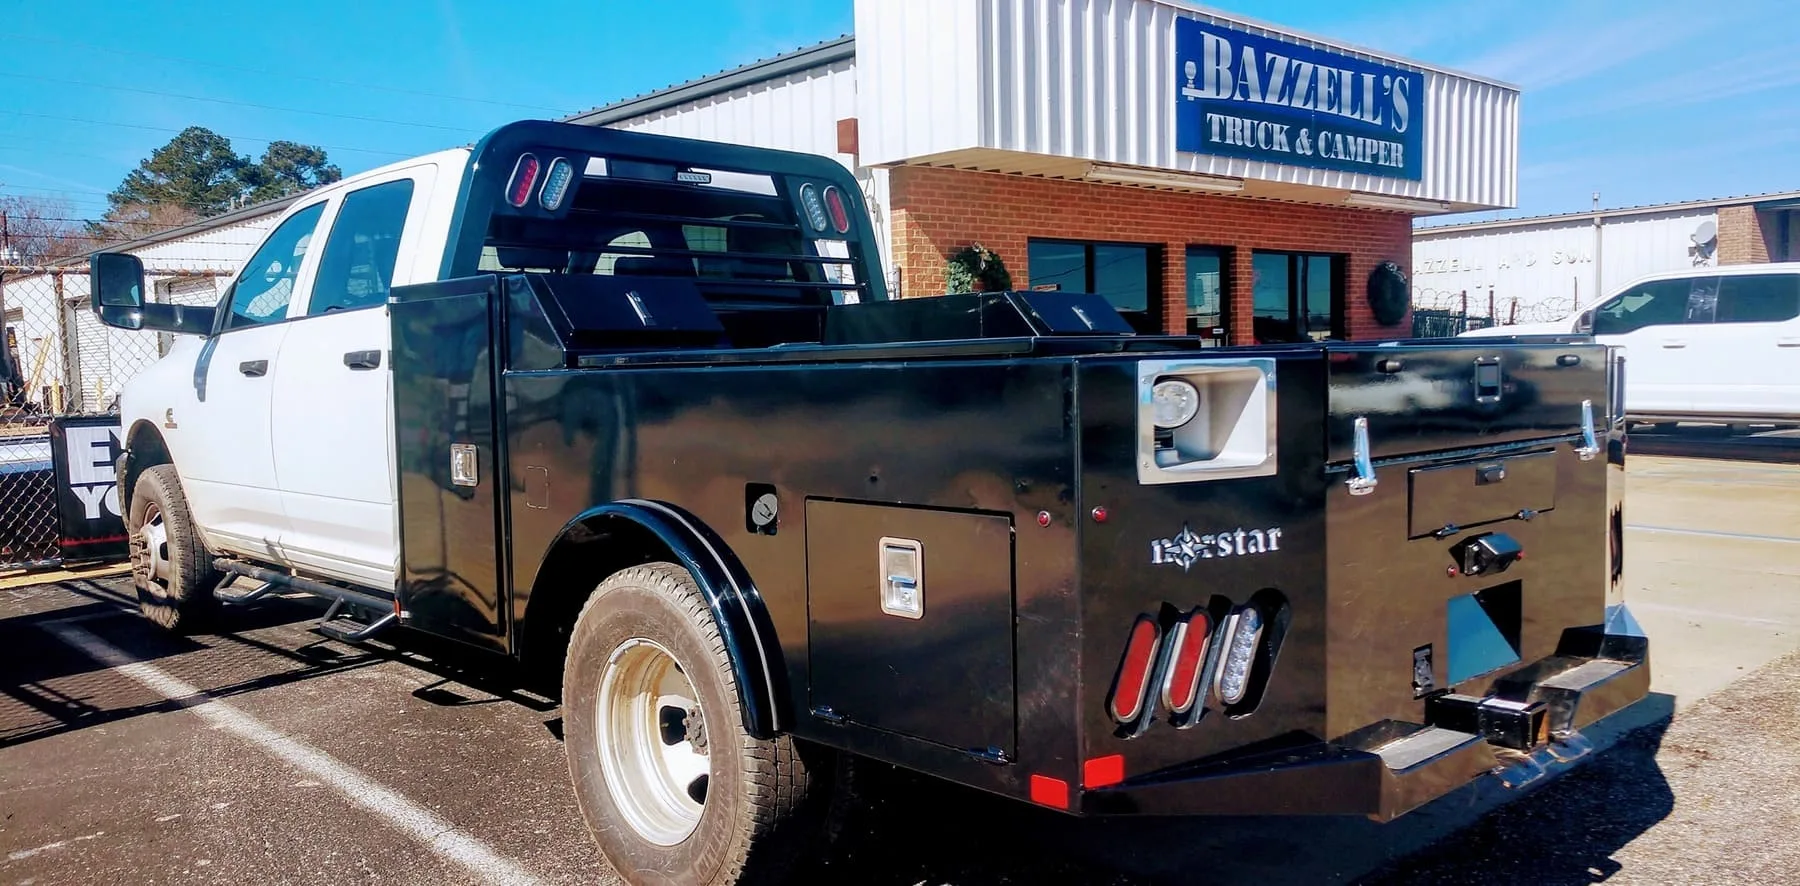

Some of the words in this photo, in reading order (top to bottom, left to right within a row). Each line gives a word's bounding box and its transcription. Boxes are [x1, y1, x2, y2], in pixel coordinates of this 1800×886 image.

[1198, 31, 1410, 134] BAZZELL'S
[1206, 112, 1291, 153] TRUCK
[1295, 127, 1313, 156] &
[1318, 130, 1404, 168] CAMPER
[65, 426, 122, 484] E
